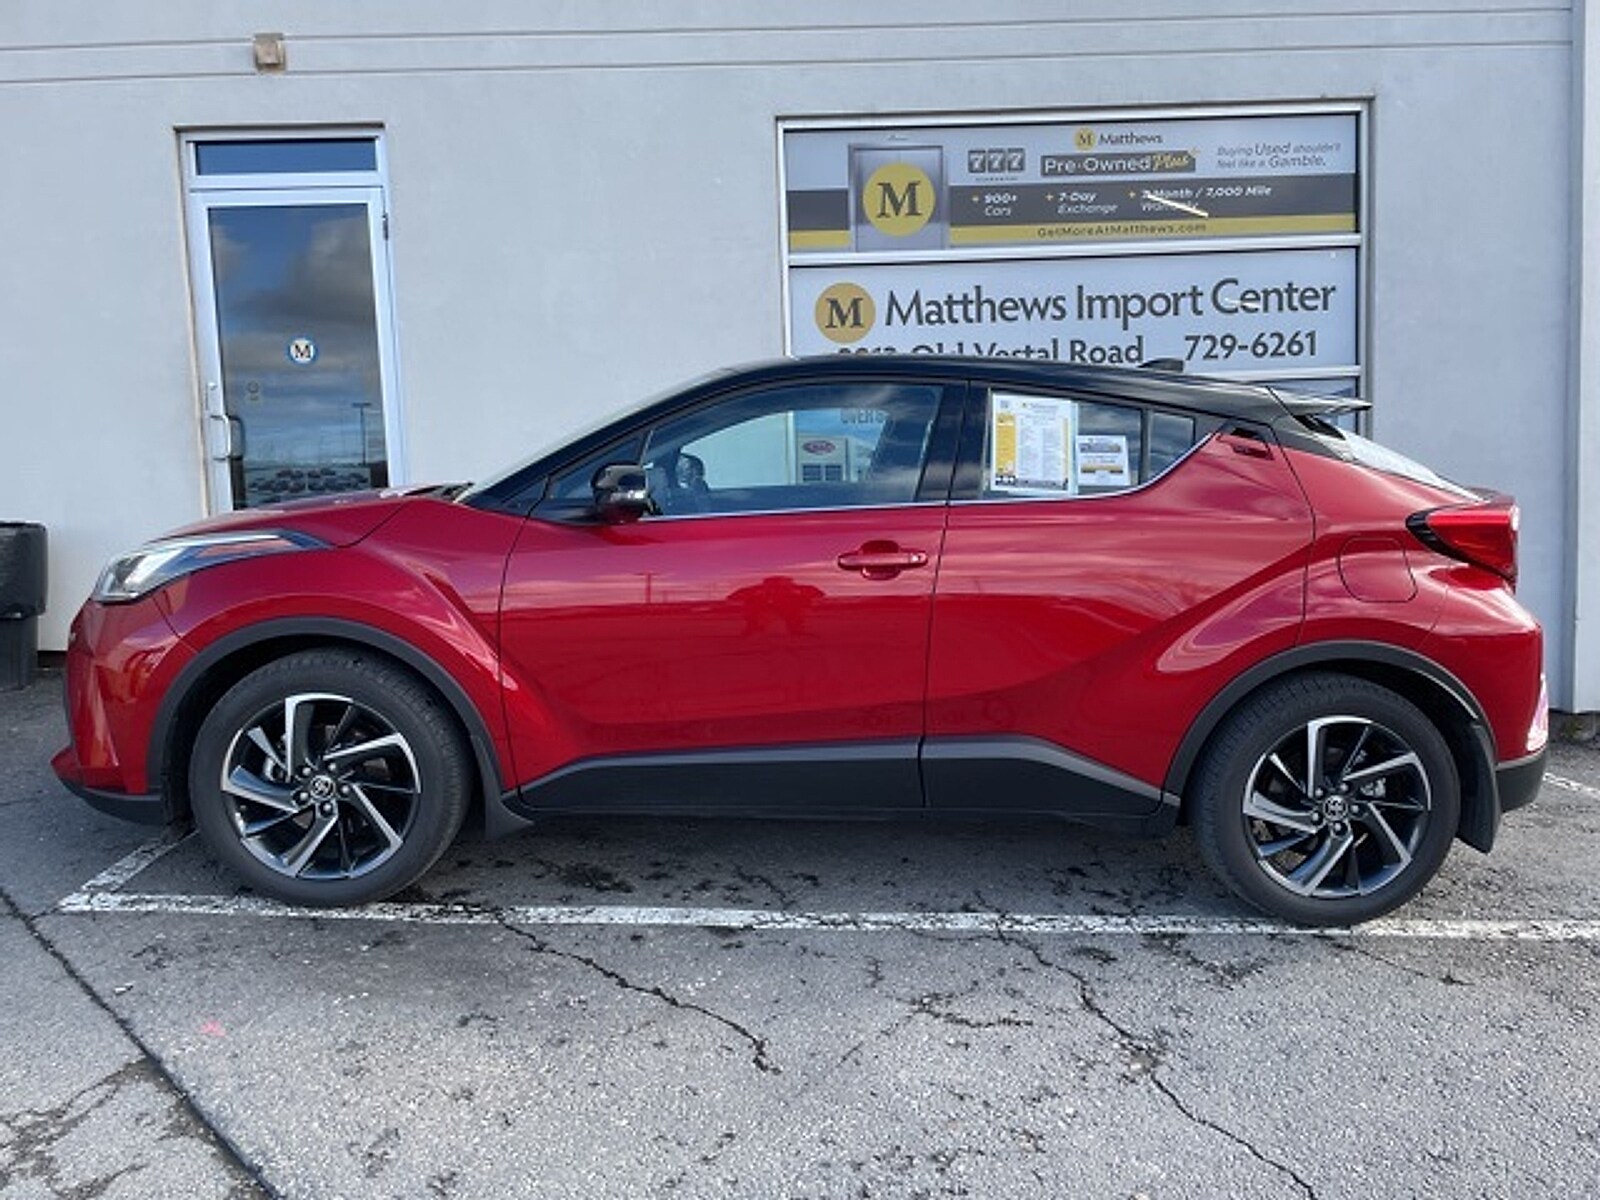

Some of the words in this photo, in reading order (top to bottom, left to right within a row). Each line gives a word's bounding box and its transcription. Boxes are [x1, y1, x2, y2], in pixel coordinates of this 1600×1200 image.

[1100, 131, 1163, 146] Matthews
[1254, 142, 1291, 156] Used
[1044, 156, 1151, 174] Pre-Owned
[1268, 154, 1327, 169] Gamble.
[1245, 185, 1273, 197] Mile
[876, 180, 923, 219] M
[984, 204, 1012, 217] Cars
[1057, 202, 1118, 216] Exchange
[1038, 224, 1207, 239] GetMoreAtMatthews.com
[884, 284, 1067, 327] Matthews
[1076, 284, 1204, 331] Import
[1211, 277, 1337, 315] Center
[824, 297, 865, 329] M
[1070, 335, 1144, 364] Road
[1184, 329, 1318, 362] 729-6261
